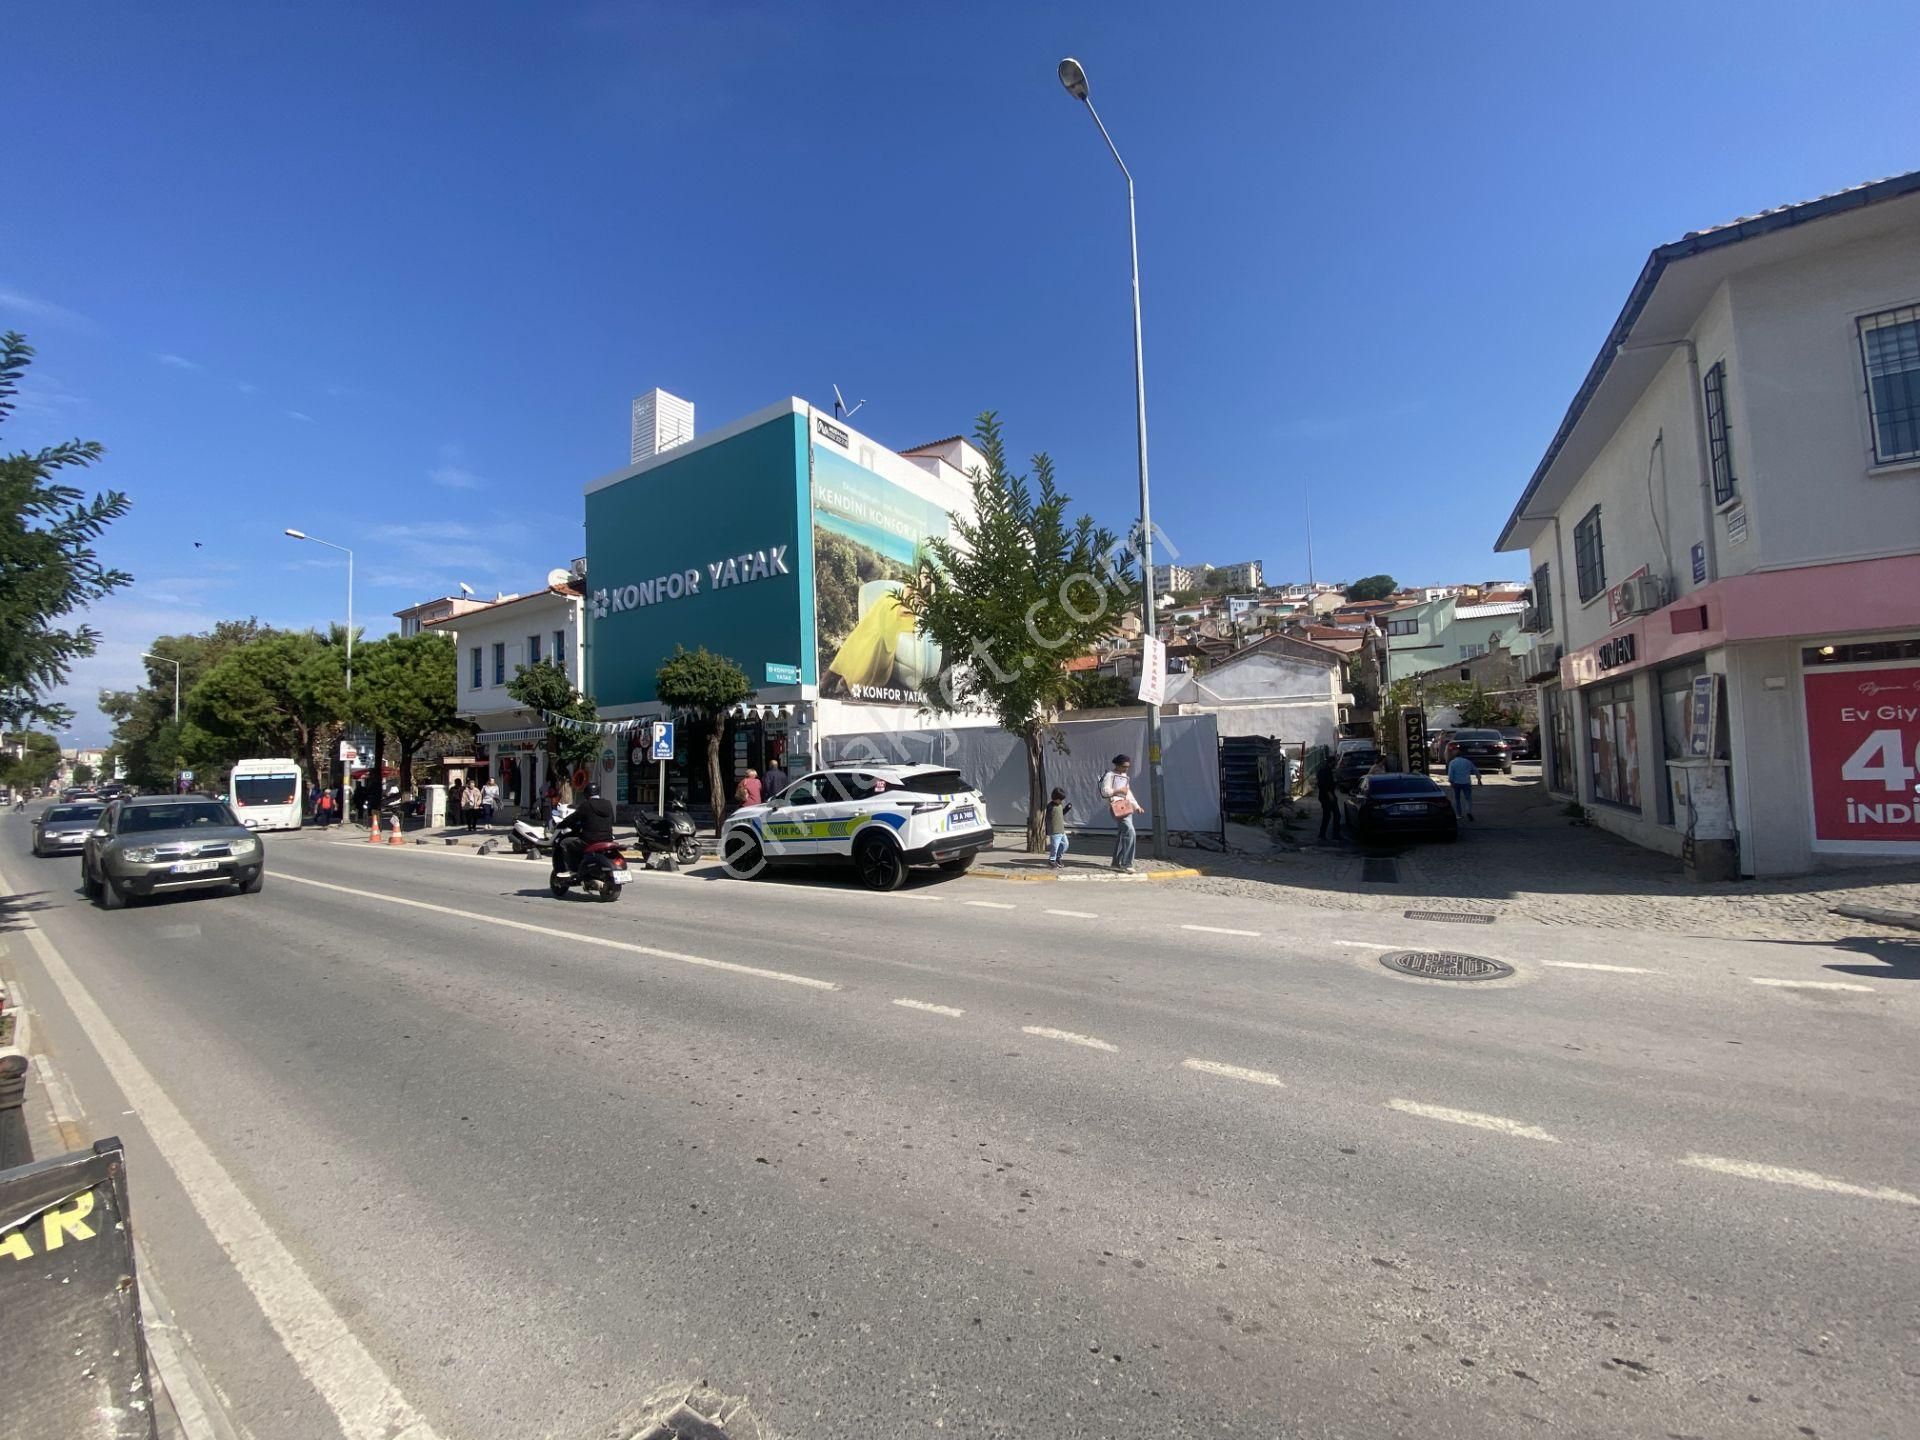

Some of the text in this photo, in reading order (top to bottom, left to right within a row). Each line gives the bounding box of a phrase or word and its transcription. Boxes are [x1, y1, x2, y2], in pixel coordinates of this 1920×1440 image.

[611, 544, 790, 613] KONFOR YATAK
[862, 685, 928, 703] KONFOR YATAK
[1841, 707, 1870, 722] Ev
[1841, 729, 1920, 791] 4
